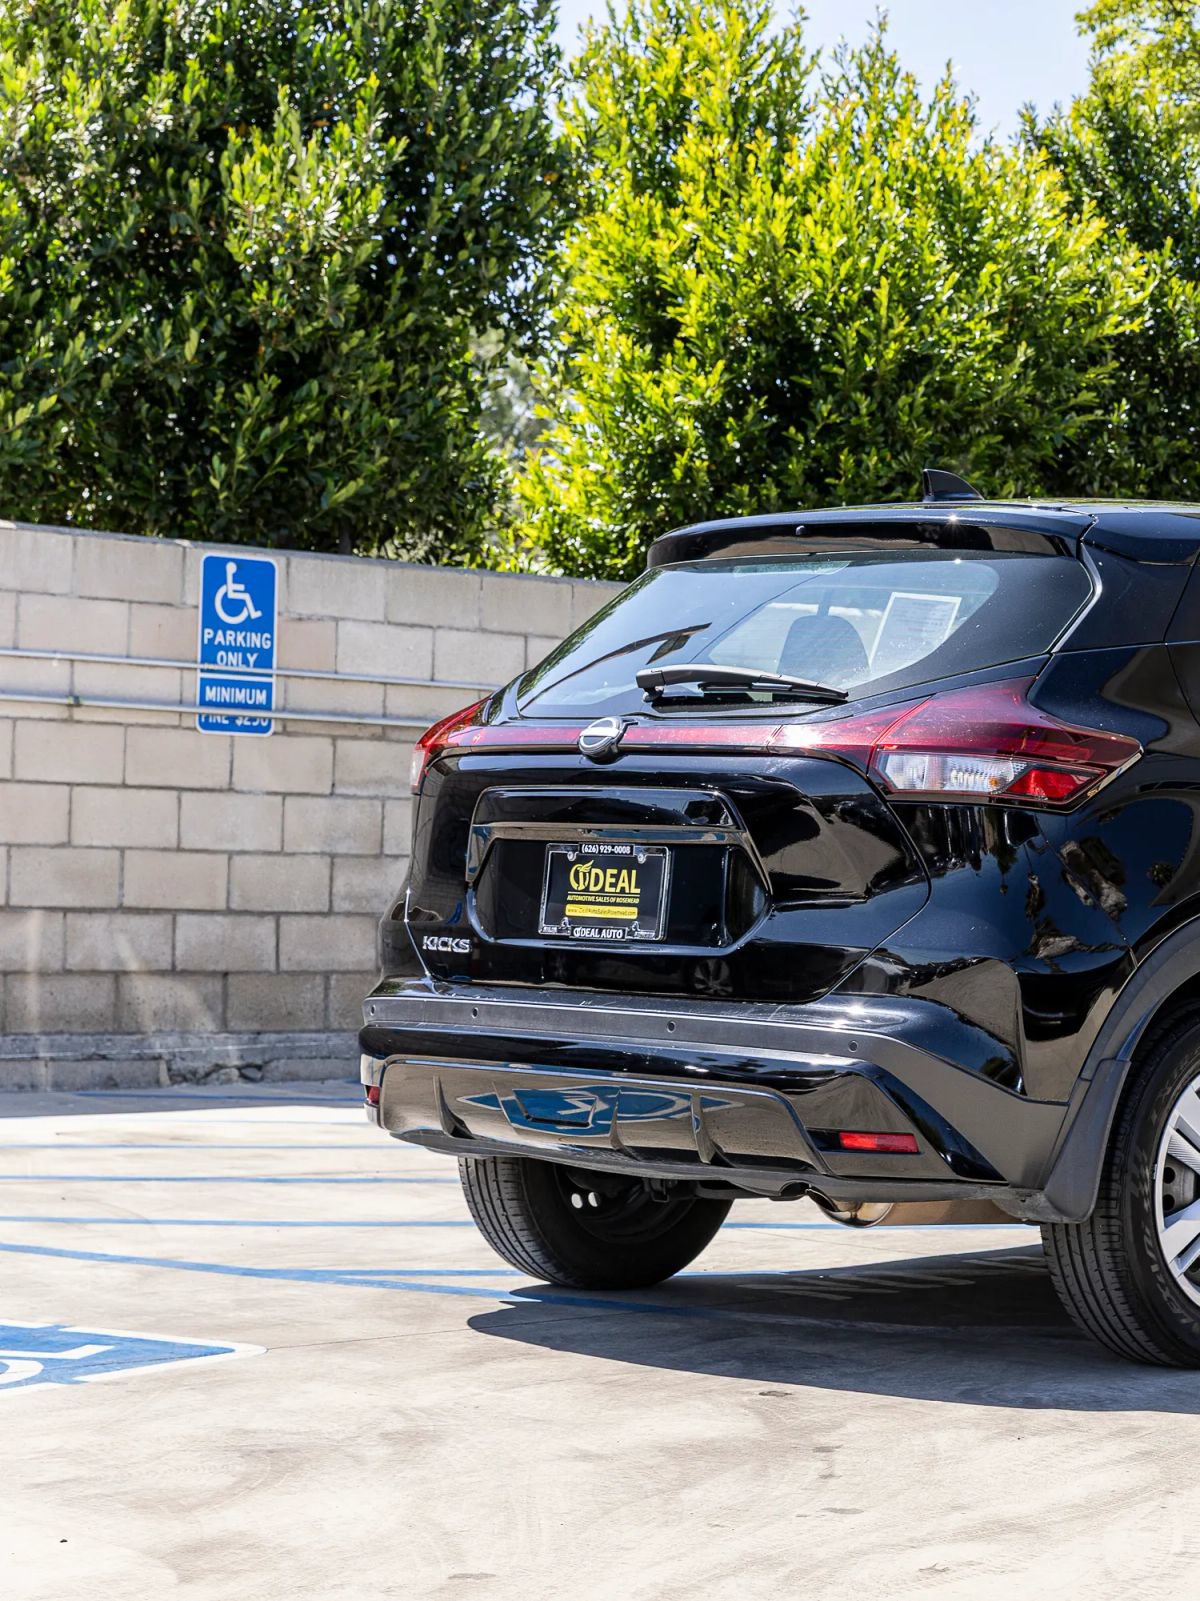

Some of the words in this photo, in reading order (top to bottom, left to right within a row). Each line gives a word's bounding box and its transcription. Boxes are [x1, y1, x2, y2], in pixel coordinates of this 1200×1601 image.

[203, 628, 271, 649] PARKING
[216, 650, 258, 668] ONLY
[205, 685, 267, 705] MINIMUM
[581, 843, 599, 854] (626)
[600, 845, 631, 854] 929-0008
[601, 928, 623, 939] AUTO
[422, 936, 472, 953] KICKS
